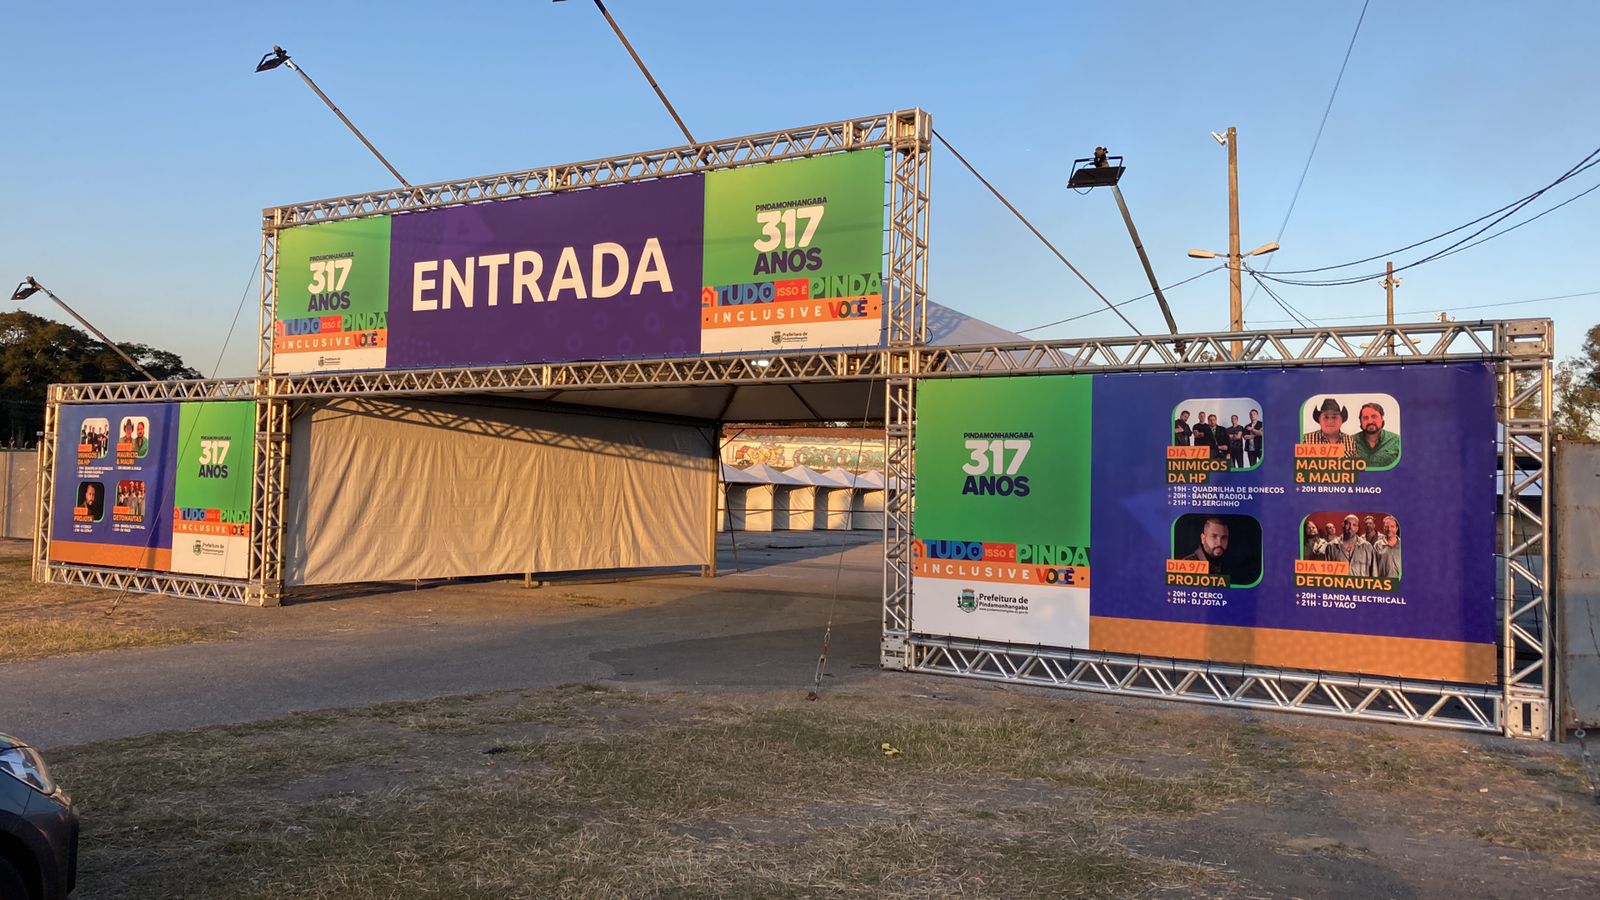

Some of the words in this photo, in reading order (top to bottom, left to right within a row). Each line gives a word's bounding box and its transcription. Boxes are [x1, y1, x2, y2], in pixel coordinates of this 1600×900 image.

[755, 196, 828, 212] PINDAMONHANGABA
[754, 206, 824, 252] 317
[753, 248, 822, 276] ANOS
[308, 258, 352, 294] 317
[412, 238, 673, 311] ENTRADA
[714, 282, 776, 306] TUDO
[776, 285, 799, 296] ISSO
[808, 272, 882, 300] PINDA
[308, 291, 350, 312] ANOS
[714, 305, 822, 323] INCLUSIVE
[828, 297, 868, 318] VOCÊ
[283, 317, 320, 336] TUDO
[342, 312, 387, 332] PINDA
[282, 337, 350, 349] INCLUSIVE
[354, 331, 378, 347] VOCÊ
[199, 440, 230, 465] 317
[962, 440, 1031, 475] 317
[1168, 449, 1189, 457] DIA
[1191, 448, 1207, 458] 7/7
[1296, 447, 1317, 456] DIA
[1320, 446, 1338, 456] 8/7
[199, 464, 228, 478] ANOS
[1168, 461, 1228, 471] INIMIGOS
[1168, 473, 1186, 483] DA
[1189, 473, 1207, 483] HP
[1296, 472, 1305, 483] &
[1310, 472, 1354, 483] MAURI
[962, 476, 1030, 497] ANOS
[182, 508, 206, 521] TUDO
[178, 523, 226, 533] INCLUSIVE
[924, 540, 983, 560] TUDO
[985, 549, 1006, 558] ISSO
[1016, 544, 1090, 567] PINDA
[923, 564, 1030, 579] INCLUSIVE
[1036, 568, 1075, 584] VOCÊ
[1168, 562, 1186, 571] DIA
[1190, 563, 1206, 572] 9/7
[1296, 562, 1316, 572] DIA
[1321, 564, 1346, 574] 10/7
[1168, 575, 1226, 587] PROJOTA
[1296, 576, 1392, 591] DETONAUTAS
[979, 594, 1016, 603] Prefeitura
[1352, 595, 1406, 604] ELECTRICALL
